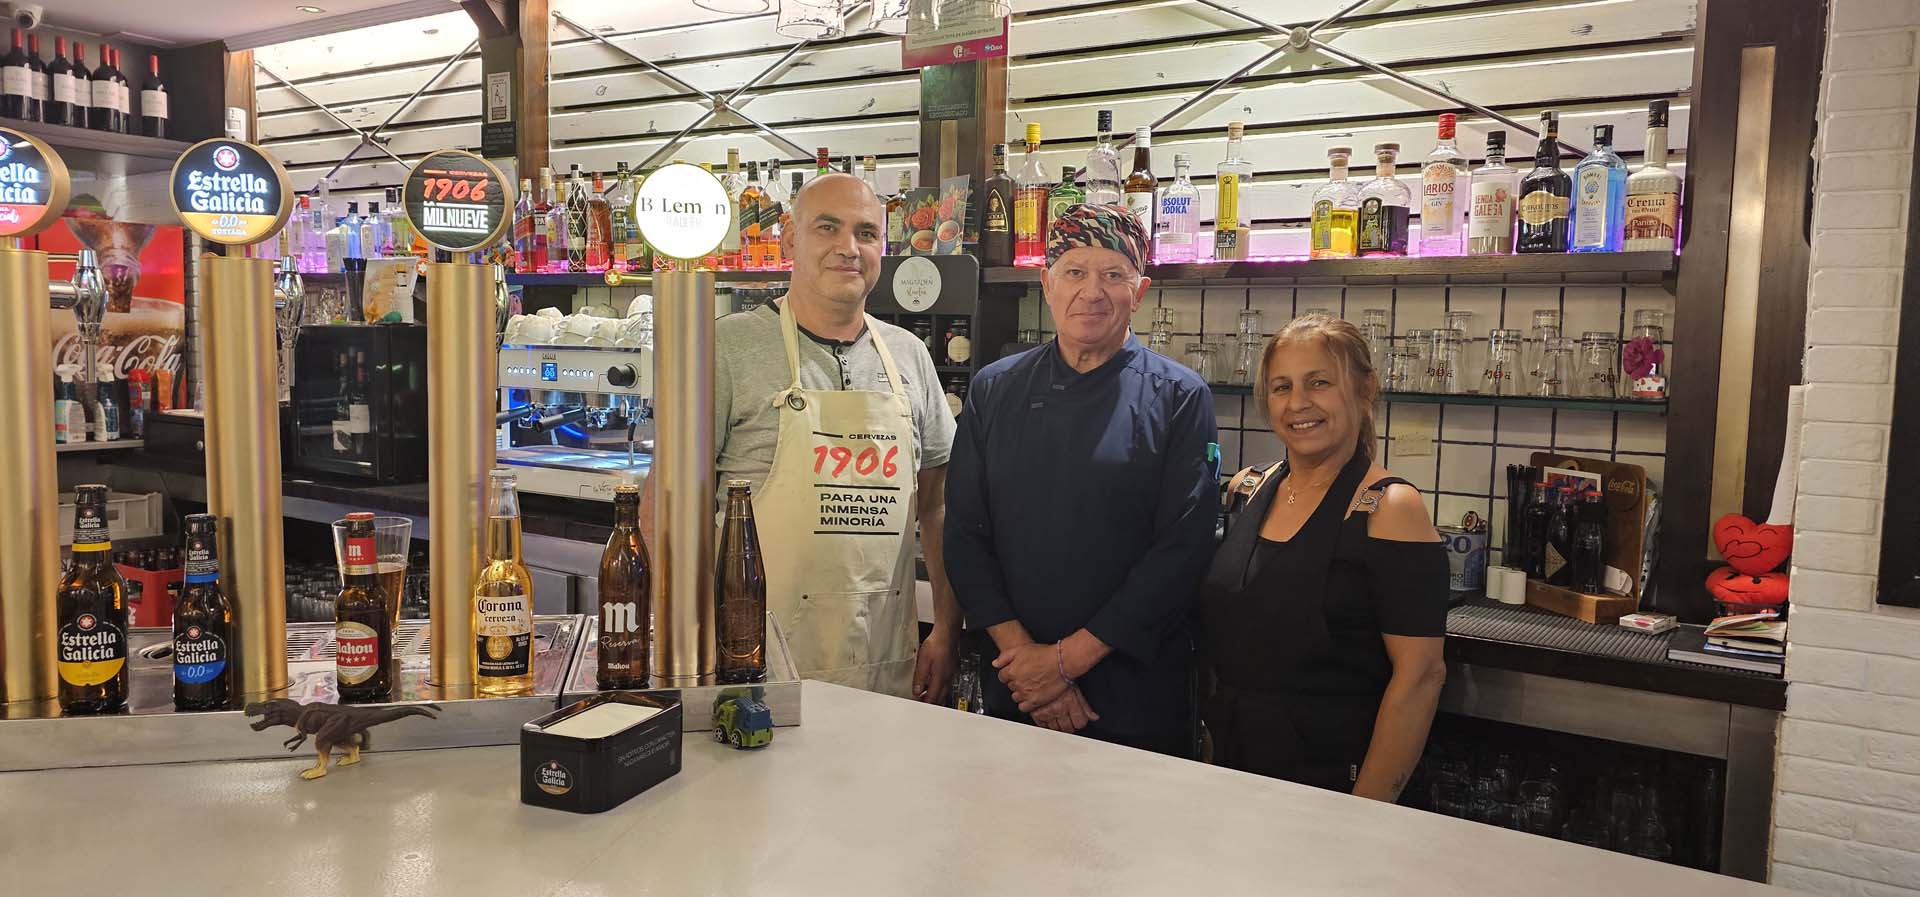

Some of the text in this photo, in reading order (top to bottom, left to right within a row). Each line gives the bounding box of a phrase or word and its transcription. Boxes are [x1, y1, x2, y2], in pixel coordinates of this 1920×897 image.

[187, 170, 268, 193] Estrella
[424, 178, 488, 201] 1906
[1424, 183, 1454, 196] LARIOS
[191, 191, 266, 213] Galicia
[1627, 198, 1665, 208] Crema
[424, 207, 488, 229] MILNUEVE
[849, 433, 897, 441] CERVEZAS
[814, 445, 898, 478] 1906
[820, 493, 897, 504] PARA UNA
[820, 505, 888, 515] INMENSA
[820, 516, 885, 527] MINORÍA
[478, 599, 522, 614] Corona
[485, 614, 516, 622] cerveza
[602, 601, 640, 633] m
[61, 632, 116, 647] Estrella
[175, 640, 218, 652] Estrella
[601, 635, 640, 650] Reserva
[62, 646, 114, 661] Galicia
[176, 651, 217, 664] Galicia
[542, 767, 566, 778] Estrella
[542, 775, 565, 786] Galicia
